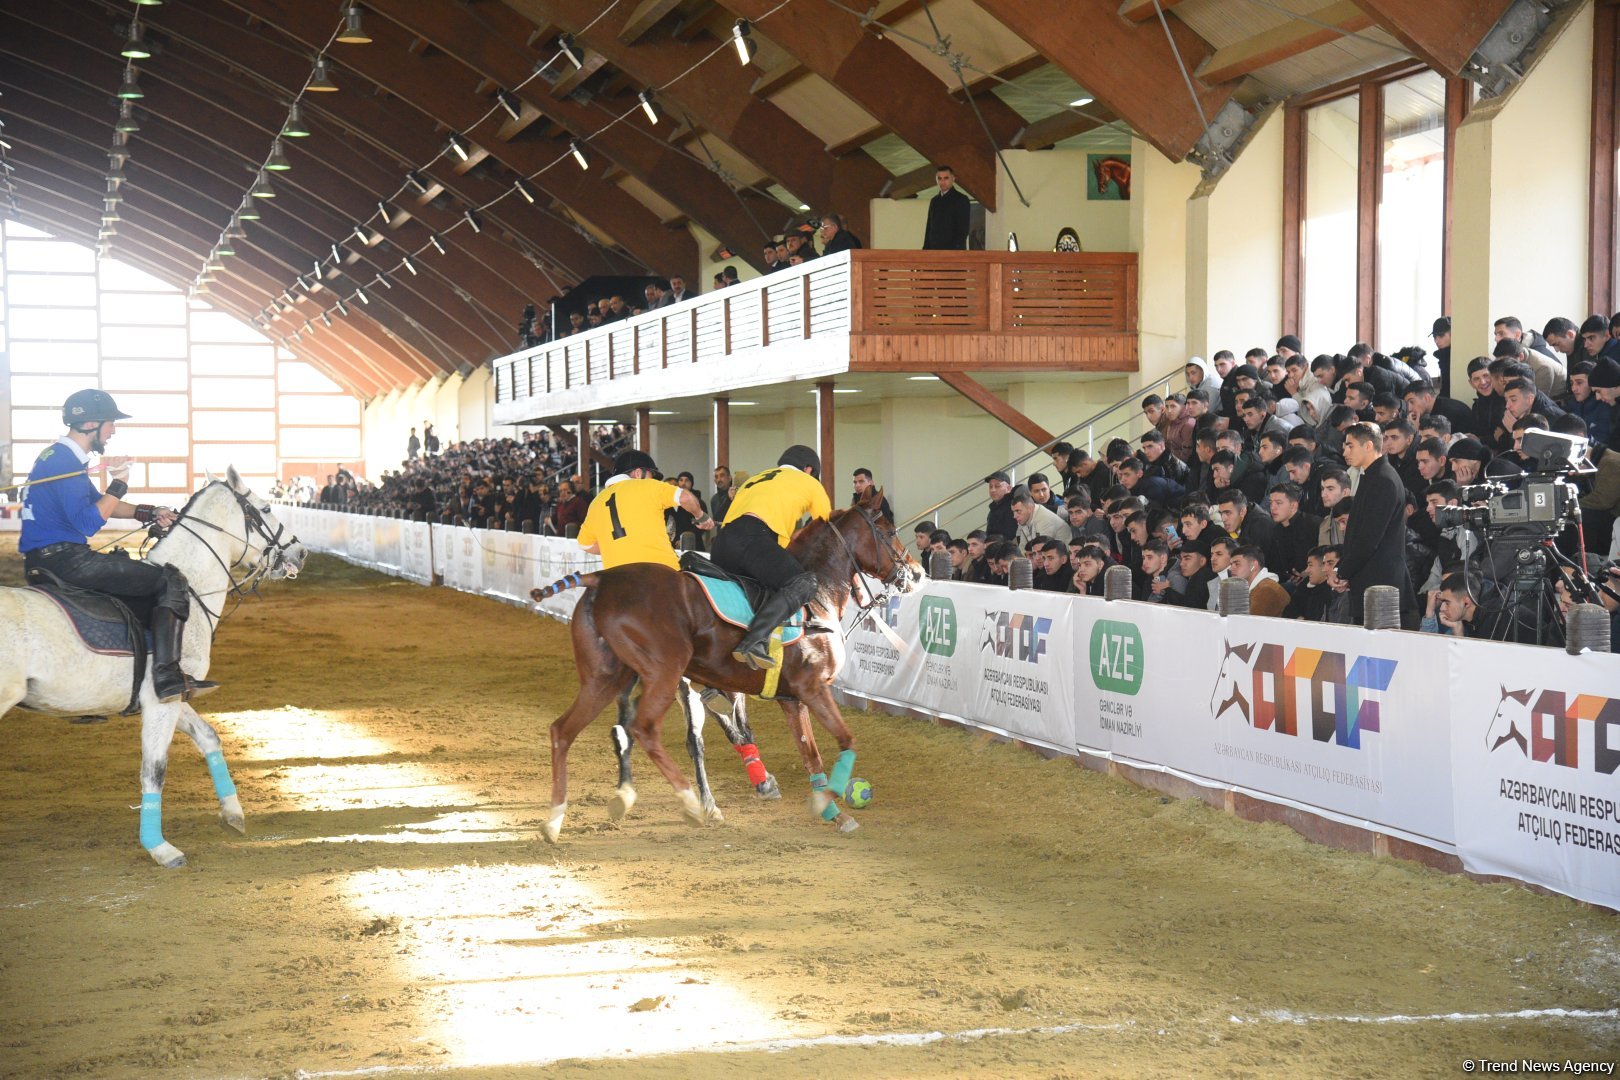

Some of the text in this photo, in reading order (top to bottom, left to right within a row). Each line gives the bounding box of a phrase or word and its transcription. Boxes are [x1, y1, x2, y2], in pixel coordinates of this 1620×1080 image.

[605, 492, 627, 541] 1
[1536, 494, 1543, 504] 3
[925, 606, 951, 646] AZE
[1098, 633, 1134, 682] AZE
[1099, 699, 1133, 718] GƏNCLƏR VƏ
[1213, 742, 1255, 762] AZƏRBAYCAN
[1303, 763, 1331, 782] ATÇILIQ
[1332, 769, 1383, 794] FEDERASİYASI
[1500, 778, 1620, 823] AZƏRBAYCAN RESPU
[1518, 812, 1620, 856] ATÇILIQ FEDERAS
